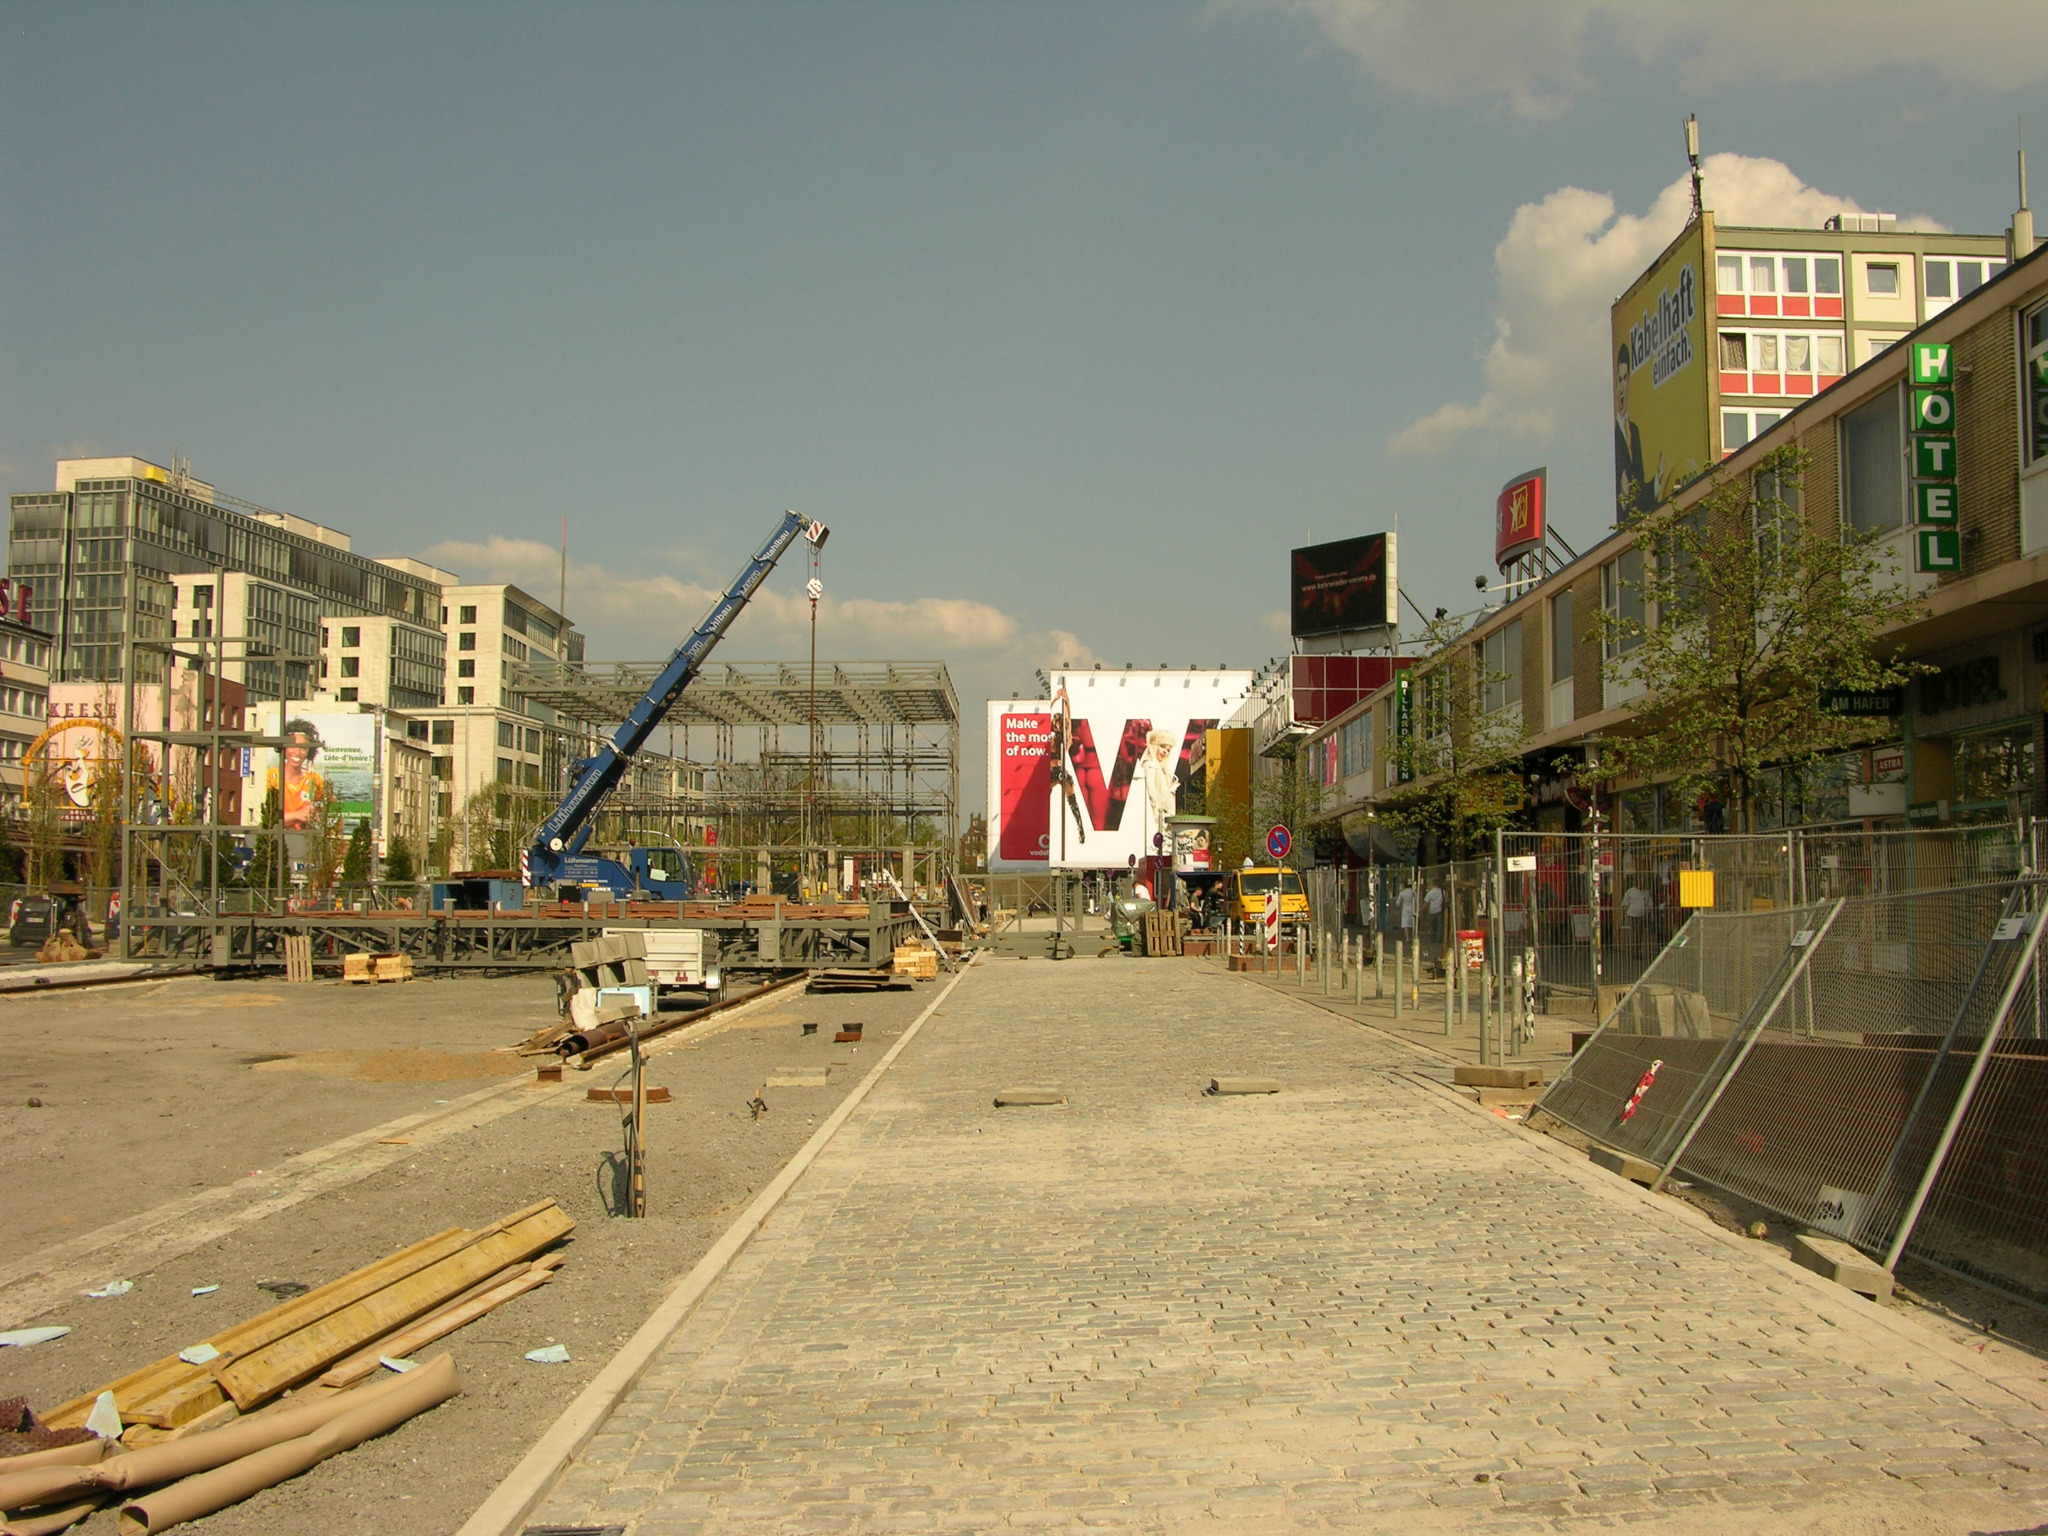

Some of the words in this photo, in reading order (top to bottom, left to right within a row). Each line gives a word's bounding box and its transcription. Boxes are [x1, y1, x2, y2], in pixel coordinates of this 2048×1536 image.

[1630, 266, 1694, 372] Kabelhaft
[1652, 328, 1691, 387] einfach.
[1920, 347, 1954, 566] HOTEL
[761, 529, 790, 560] Stahlbau
[48, 702, 117, 718] KEESE
[1830, 695, 1850, 711] AM
[1005, 717, 1039, 730] Make
[1005, 732, 1027, 743] the
[1005, 745, 1020, 757] of
[1021, 747, 1049, 757] now.
[1878, 757, 1902, 771] ASTRA
